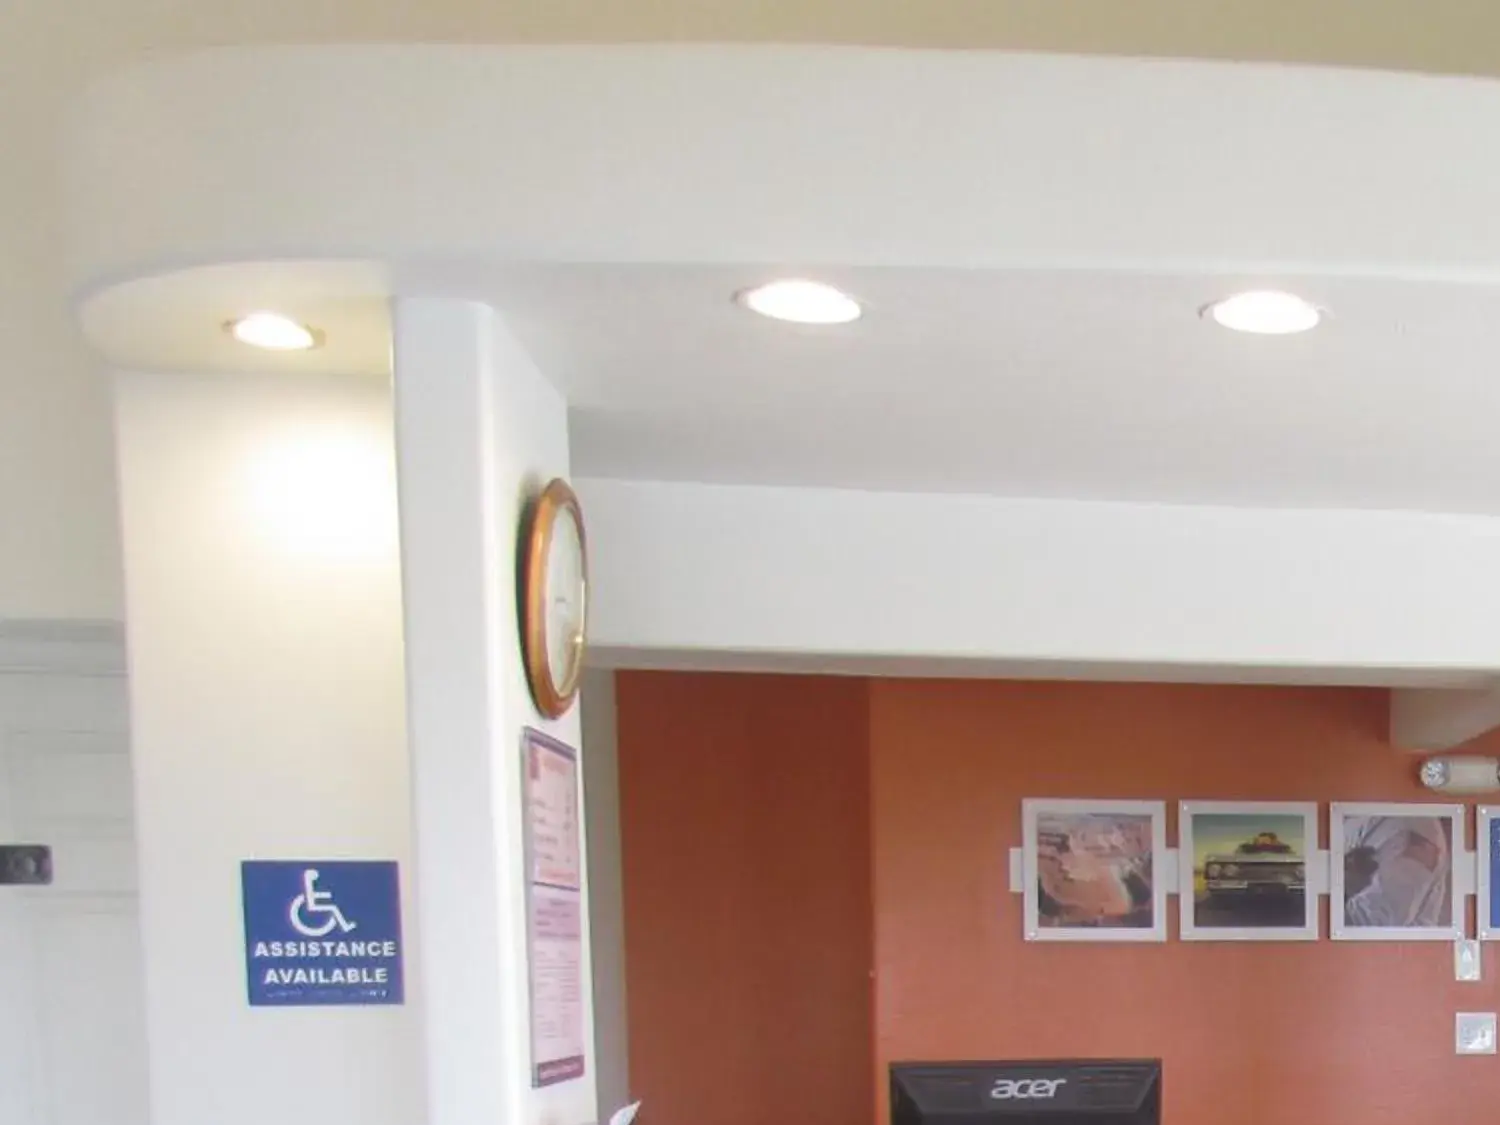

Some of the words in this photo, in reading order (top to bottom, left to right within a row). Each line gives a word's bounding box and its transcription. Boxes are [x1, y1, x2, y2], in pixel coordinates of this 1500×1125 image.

[255, 941, 396, 957] ASSISTANCE
[264, 967, 388, 984] AVAILABLE
[991, 1079, 1067, 1099] acer
